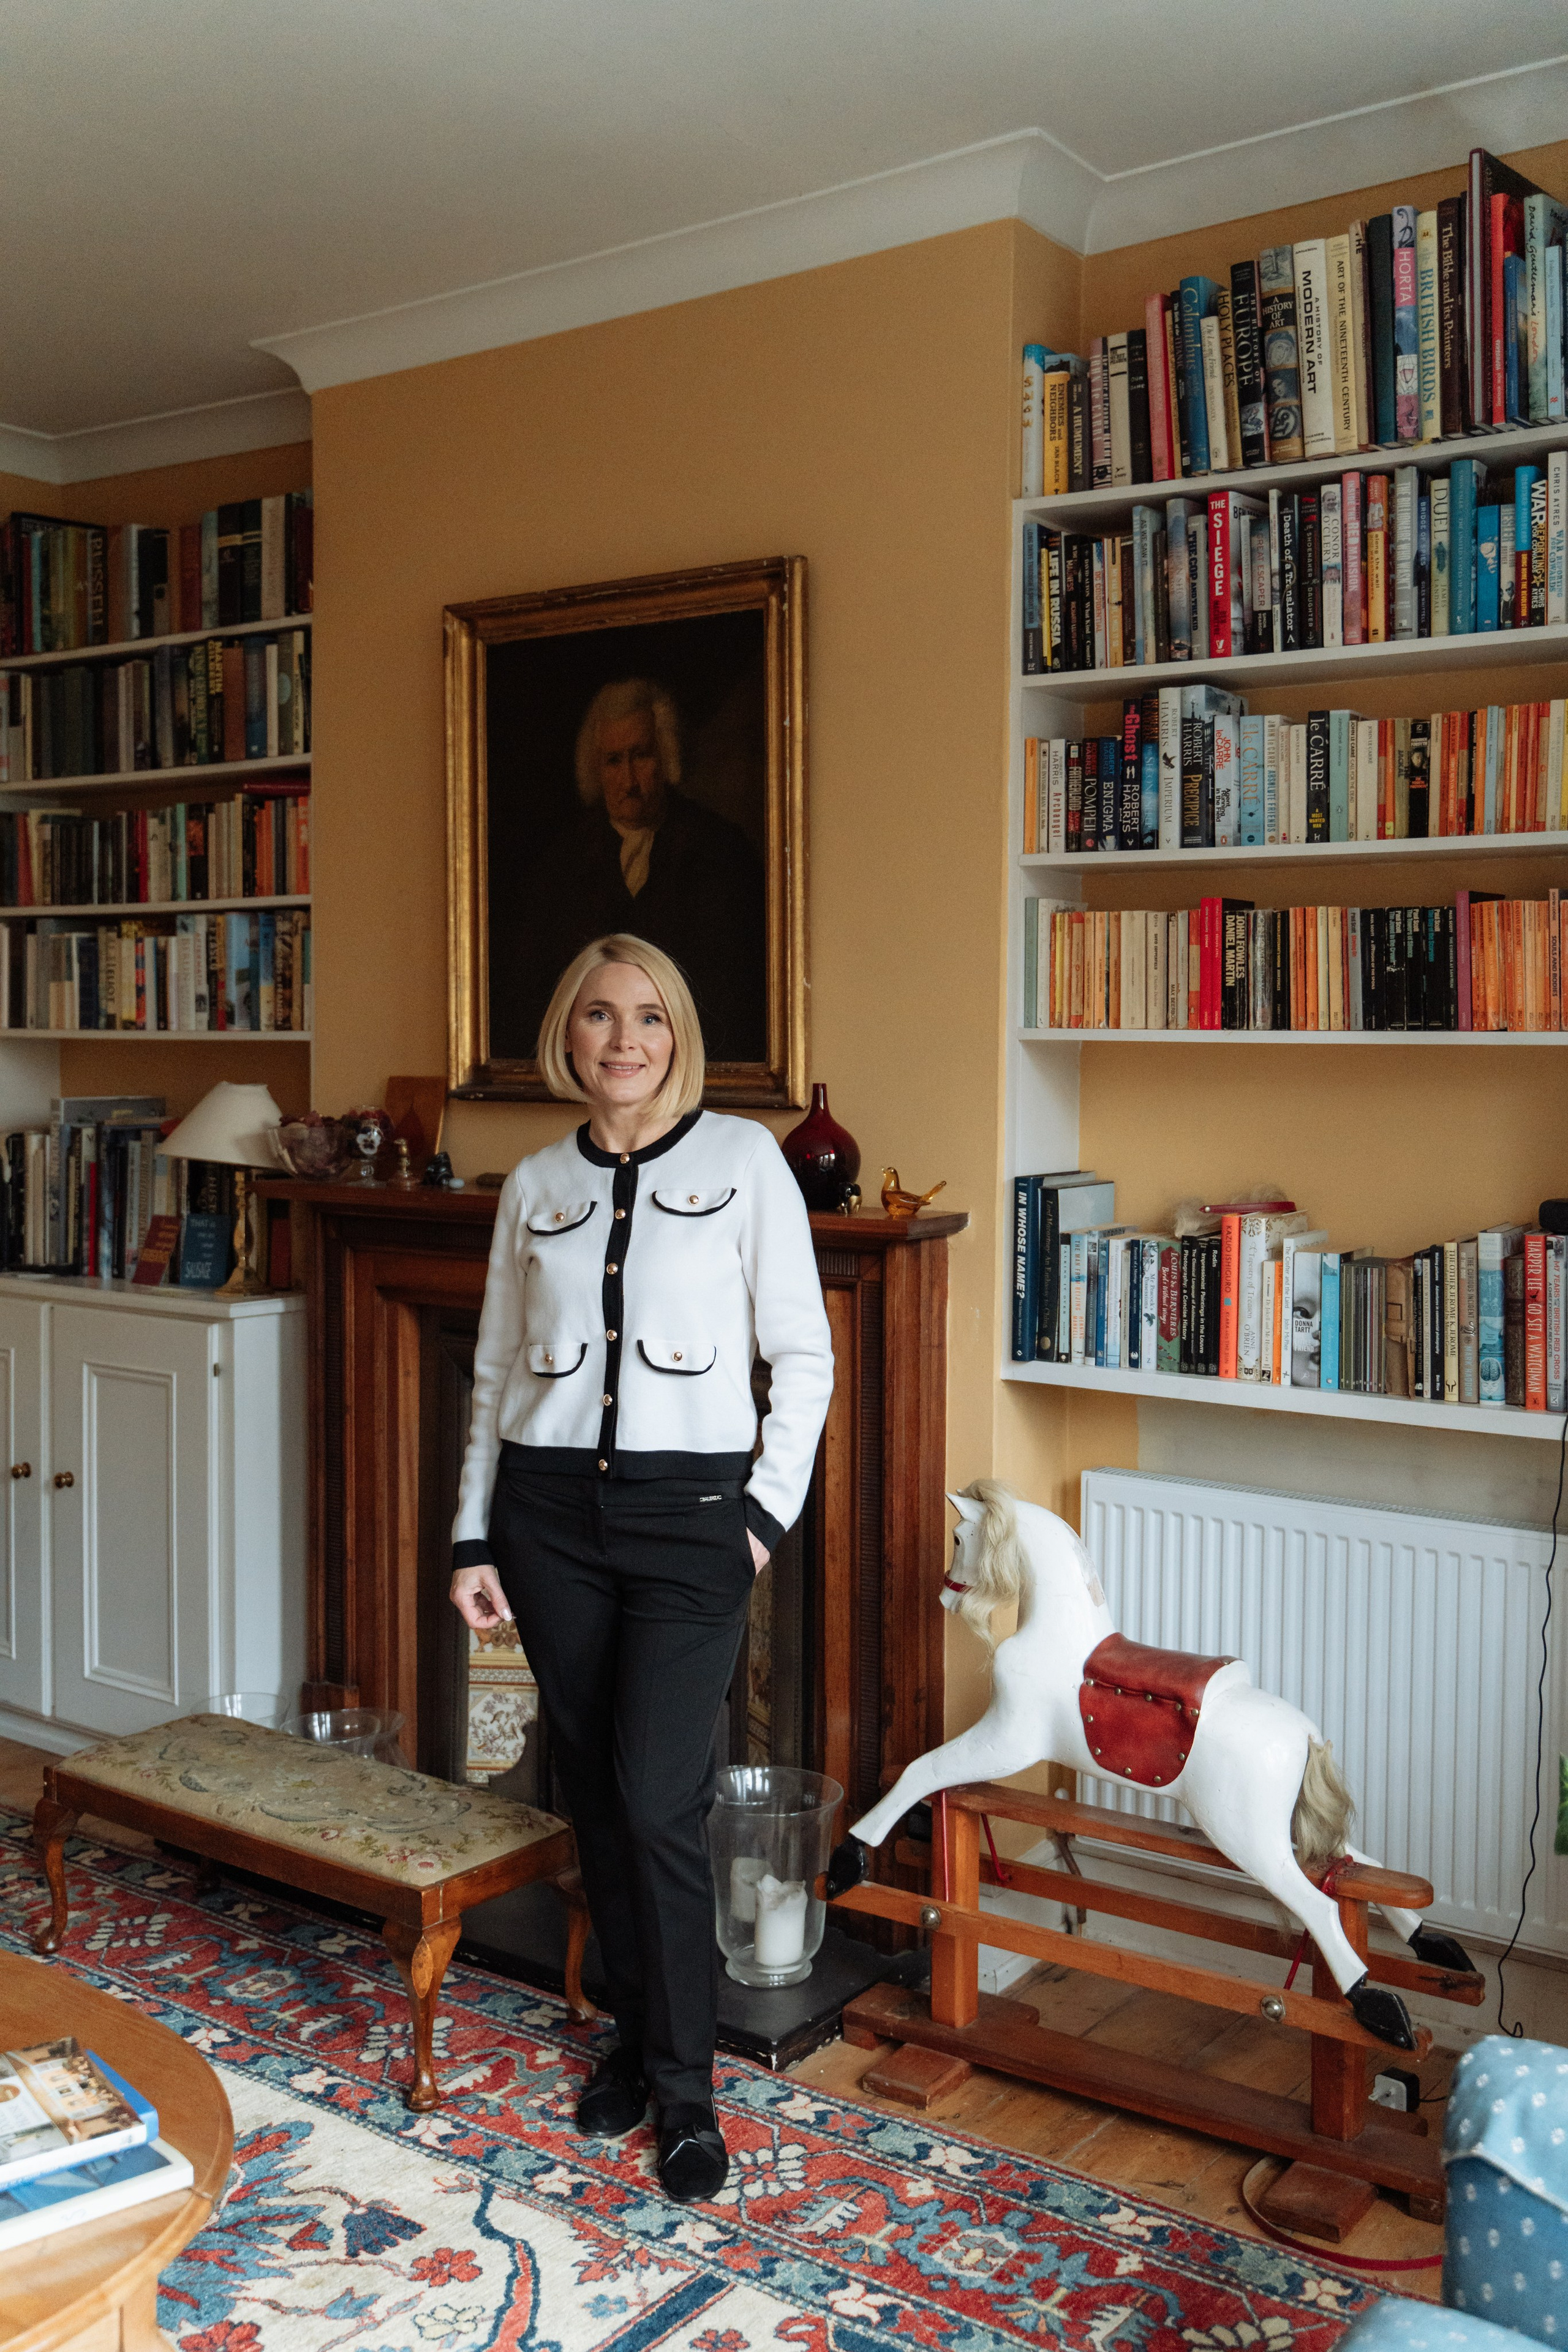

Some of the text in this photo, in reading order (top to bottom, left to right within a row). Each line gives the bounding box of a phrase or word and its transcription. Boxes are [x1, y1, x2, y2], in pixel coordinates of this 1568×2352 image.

[1528, 206, 1537, 241] David
[1338, 282, 1345, 293] OF
[1399, 251, 1412, 303] HORTA
[1442, 224, 1453, 369] The Bible and its Painters
[1526, 245, 1539, 316] Gentleman's
[1182, 288, 1200, 369] Columbus
[1218, 294, 1231, 332] HOLY
[1263, 303, 1293, 313] HISTORY
[1234, 294, 1253, 389] EUROPE
[1302, 270, 1316, 394] MODERN ART
[1420, 268, 1436, 402] BRITISH BIRDS
[1221, 338, 1234, 388] PLACES
[1255, 371, 1260, 383] OF
[1210, 500, 1226, 510] THE
[1434, 487, 1447, 540] DUEL
[1531, 480, 1546, 524] WAR
[1213, 513, 1224, 596] SIEGE
[1285, 549, 1292, 560] of
[1348, 522, 1359, 544] RED
[1397, 482, 1411, 589] THE BILLIONAIRE WHO WASN'T
[1189, 557, 1198, 580] COP
[1348, 547, 1357, 590] MANSION
[1049, 551, 1060, 647] LIFE IN RUSSIA
[1125, 715, 1139, 761] Ghost
[1183, 724, 1192, 766] HARRIS
[1193, 723, 1202, 764] ROBERT
[1311, 718, 1325, 791] le CARRÉ
[1243, 731, 1261, 806] le CARRÉ
[1053, 793, 1061, 837] Archangel
[1084, 778, 1096, 831] POMPEII
[1103, 782, 1113, 832] ENIGMA
[1164, 777, 1173, 823] IMPERIUM
[1183, 774, 1202, 826] PRECIPICE
[1226, 950, 1235, 986] MARTIN
[1019, 1191, 1027, 1204] IN
[1017, 1208, 1026, 1253] WHOSE
[1528, 1242, 1541, 1290] HARPER LEE
[1554, 1261, 1559, 1272] MY
[1528, 1303, 1541, 1314] GO
[1528, 1318, 1541, 1331] SET
[1528, 1344, 1542, 1392] WATCHMAN
